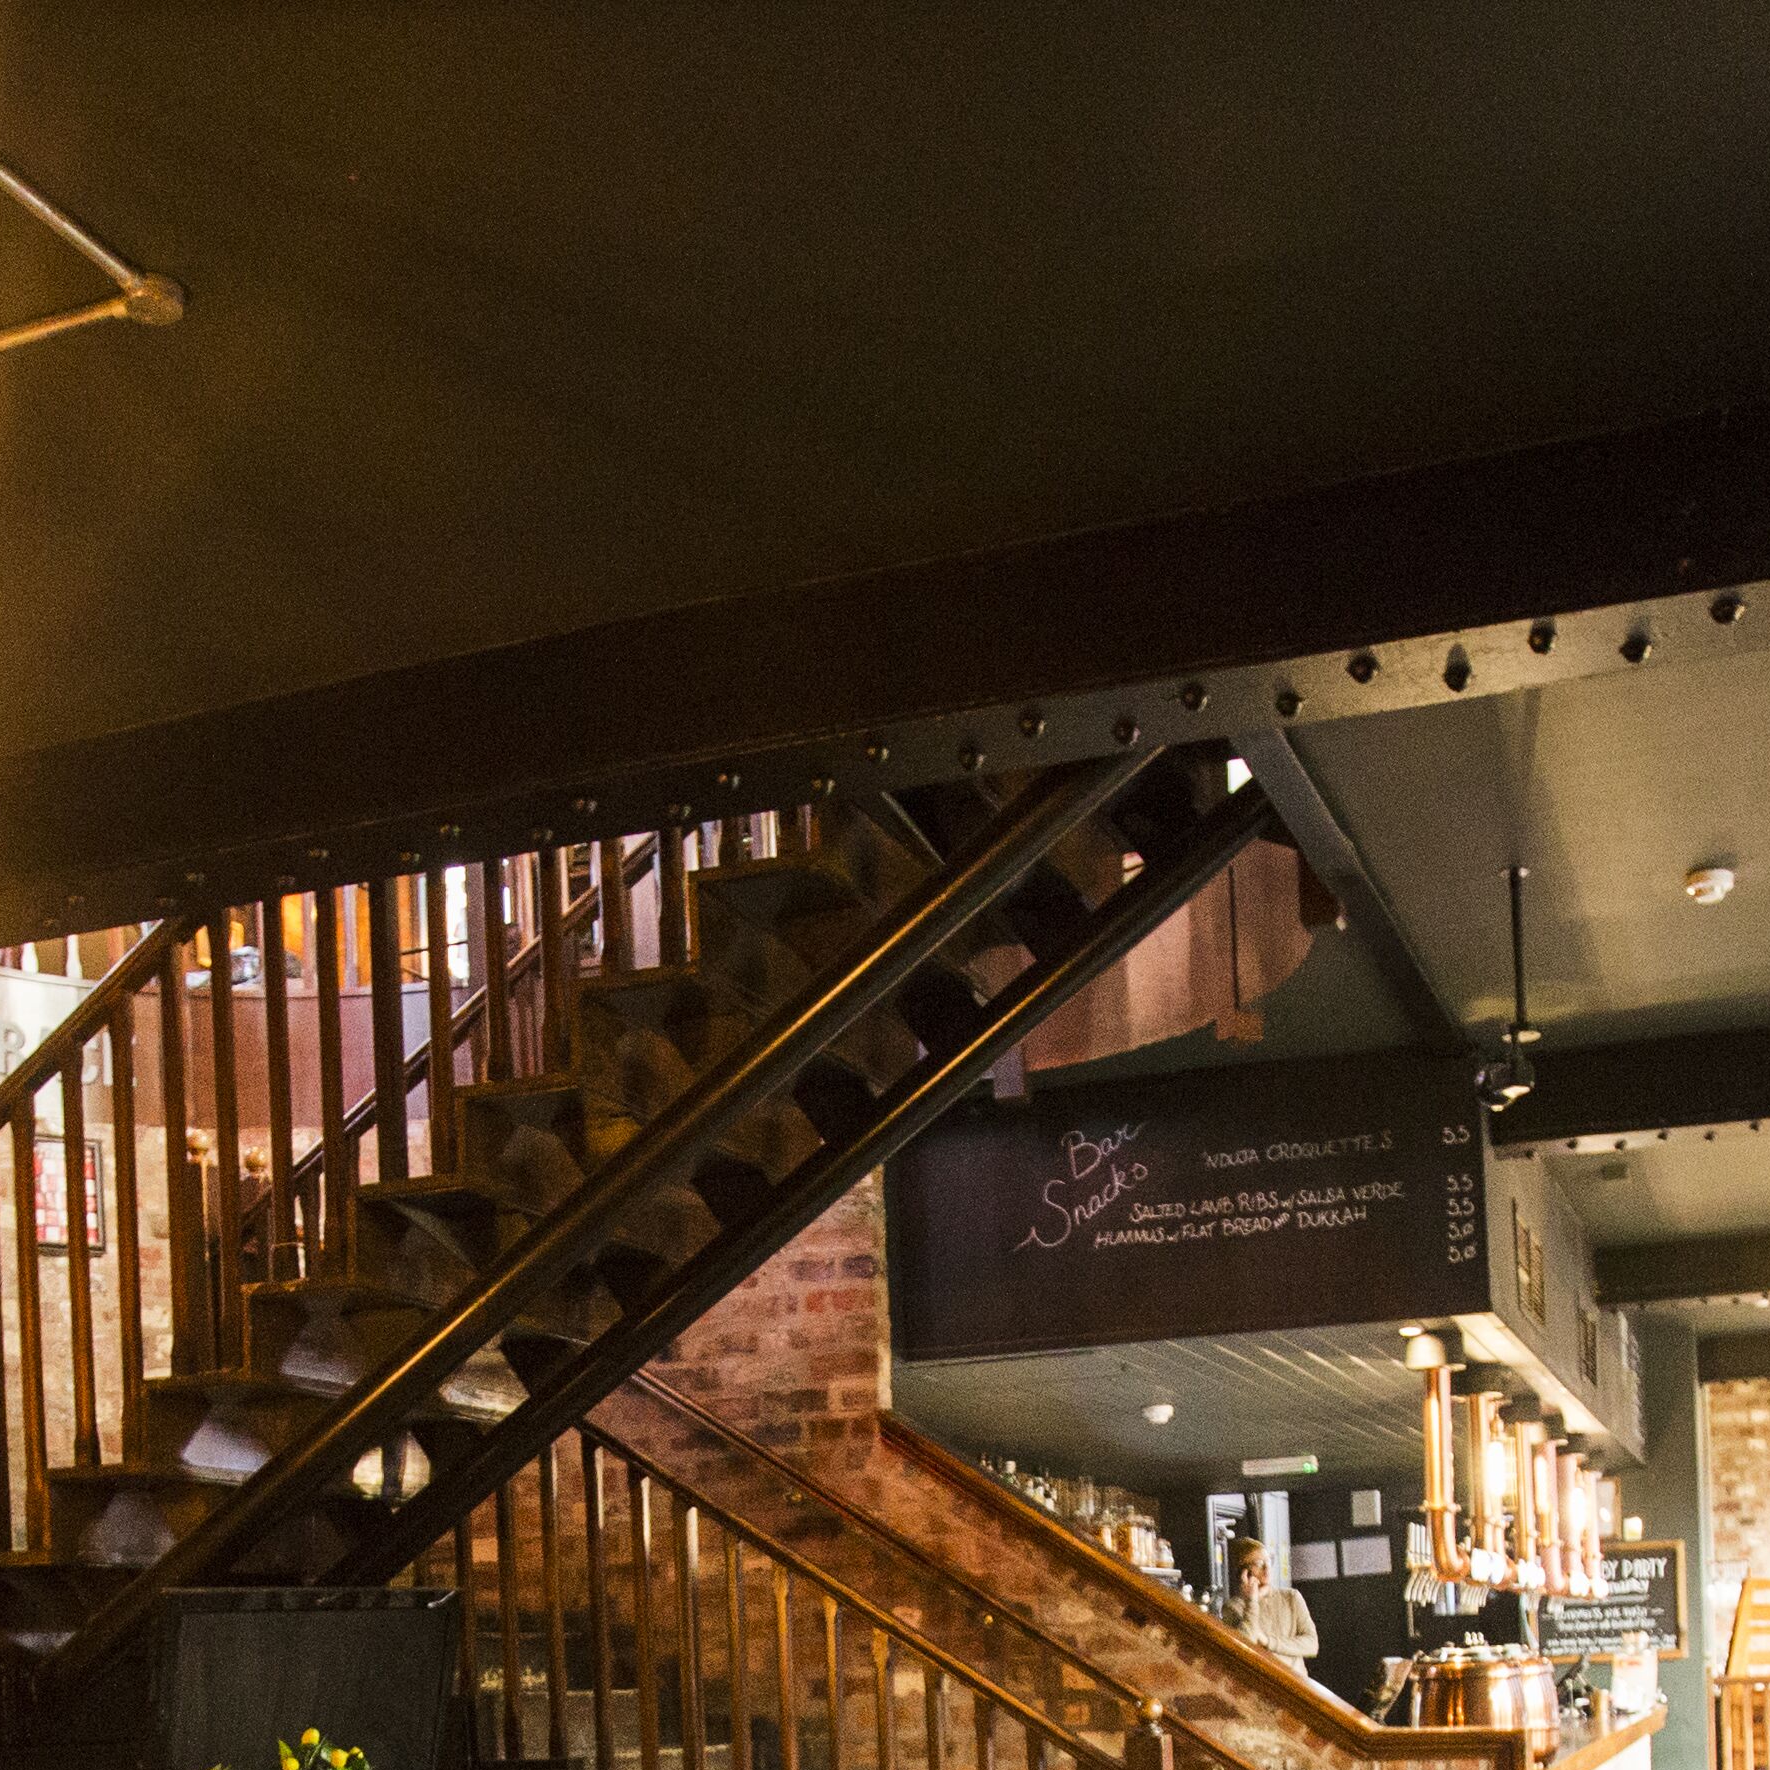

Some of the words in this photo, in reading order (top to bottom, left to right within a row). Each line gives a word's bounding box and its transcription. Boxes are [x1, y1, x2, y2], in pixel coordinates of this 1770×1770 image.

[1061, 1123, 1146, 1179] Bar
[1013, 1163, 1149, 1251] Snacks
[1130, 1202, 1185, 1223] SALTED
[1190, 1196, 1234, 1216] LAMB
[1238, 1191, 1279, 1213] RIBS
[1296, 1187, 1346, 1206] SALSA
[1351, 1181, 1405, 1201] VERDE
[1094, 1227, 1165, 1249] HUMMUS
[1183, 1221, 1219, 1240] FLAT
[1222, 1216, 1272, 1238] BREAD
[1296, 1205, 1368, 1229] DUKKAH
[1621, 1557, 1668, 1579] PARTY
